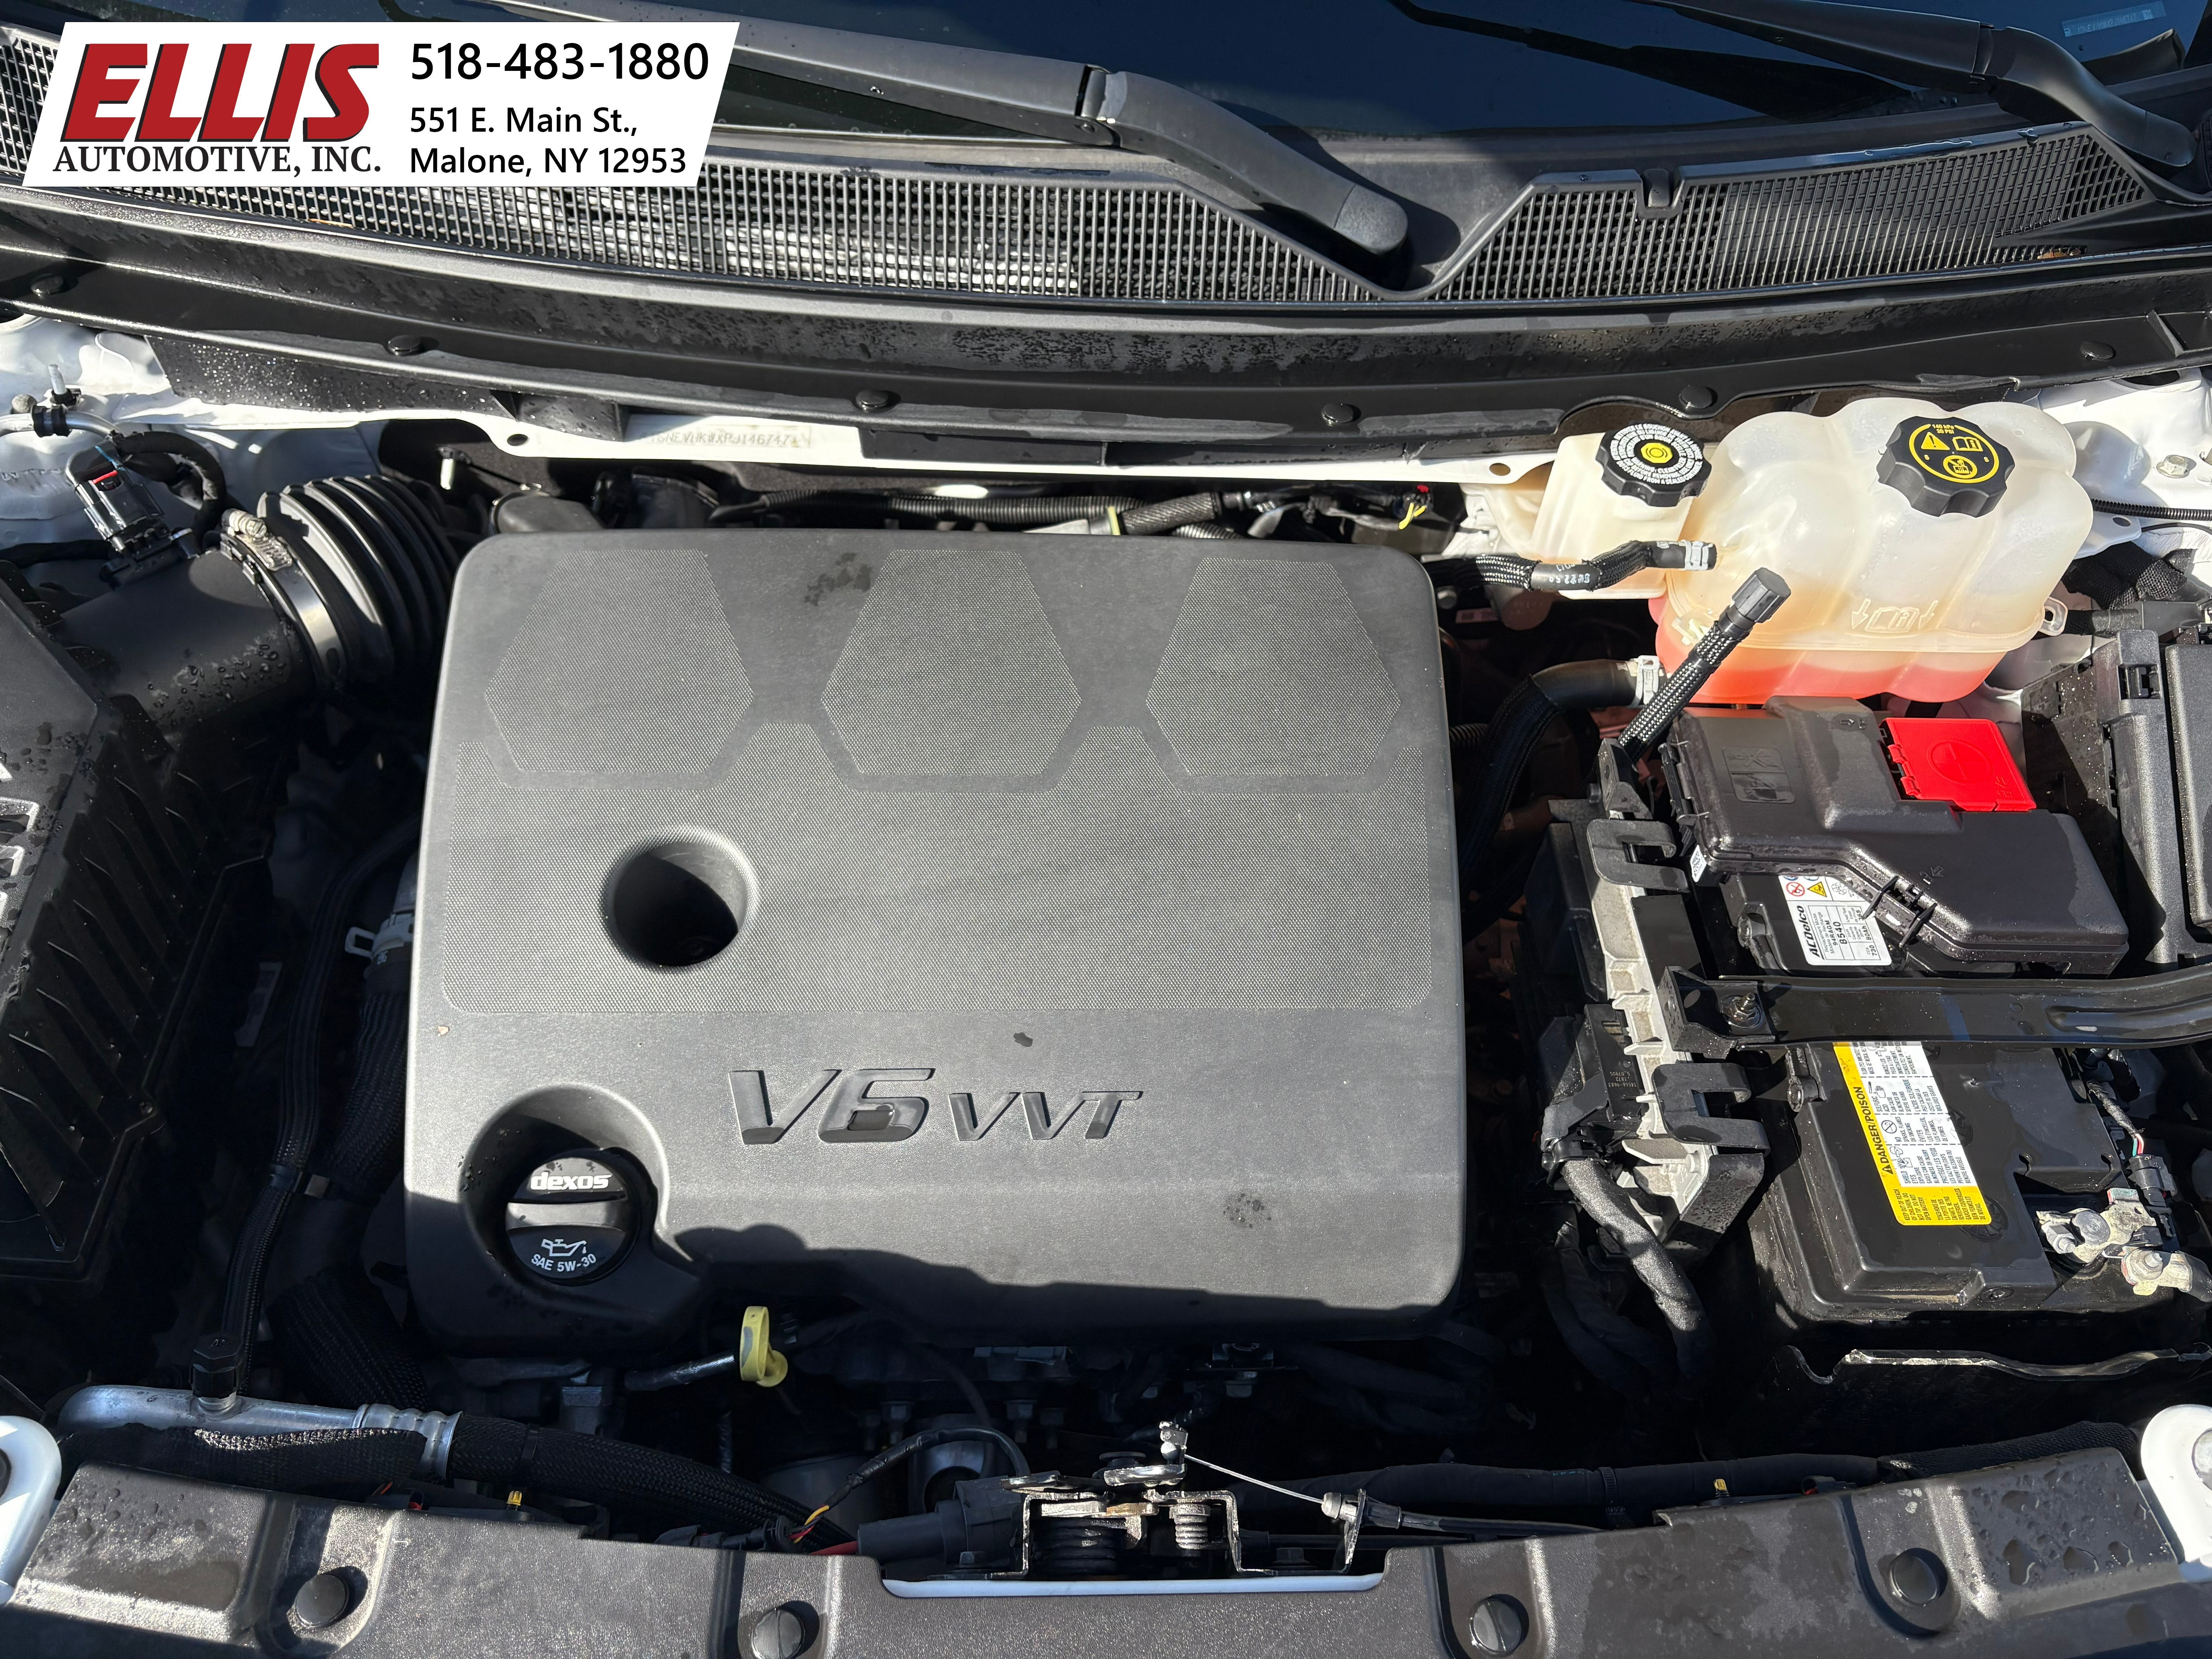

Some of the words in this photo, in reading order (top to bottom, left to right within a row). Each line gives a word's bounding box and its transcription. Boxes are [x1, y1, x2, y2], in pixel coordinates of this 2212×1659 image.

[1796, 906, 1820, 957] ACDelco
[1824, 920, 1838, 945] 94RAGM
[1832, 922, 1848, 944] 8540
[1861, 926, 1872, 940] 80Ah
[1869, 945, 1877, 956] 730
[728, 1067, 936, 1145] V6
[947, 1089, 1144, 1141] VVT
[1853, 1087, 1890, 1163] DANGER/POISON
[530, 1171, 612, 1190] dexos
[1900, 1171, 1911, 1183] SHIELD
[1893, 1189, 1903, 1199] REACH
[1917, 1197, 1928, 1211] BATTERY
[531, 1254, 554, 1271] SAE
[557, 1253, 596, 1272] 5W-30
